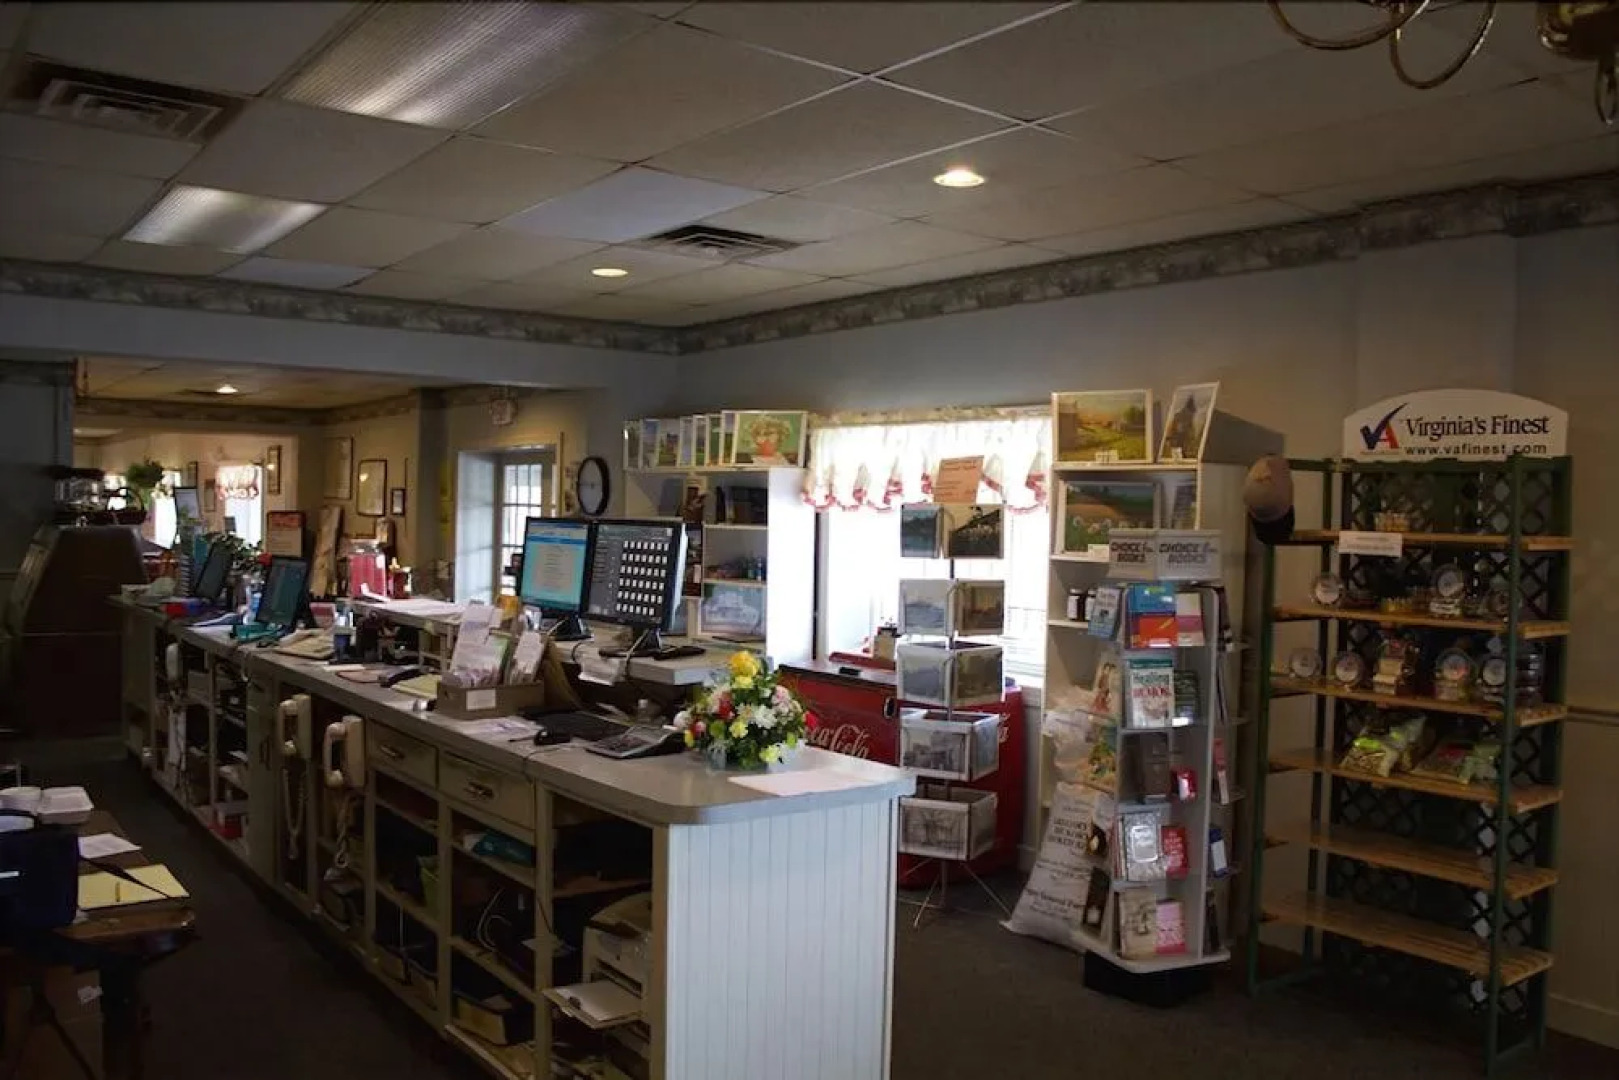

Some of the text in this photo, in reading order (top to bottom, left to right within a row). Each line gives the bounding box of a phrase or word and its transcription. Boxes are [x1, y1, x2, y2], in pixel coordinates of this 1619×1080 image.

[1406, 413, 1550, 442] Virginia's Finest
[1404, 443, 1547, 455] www.vafinest.com
